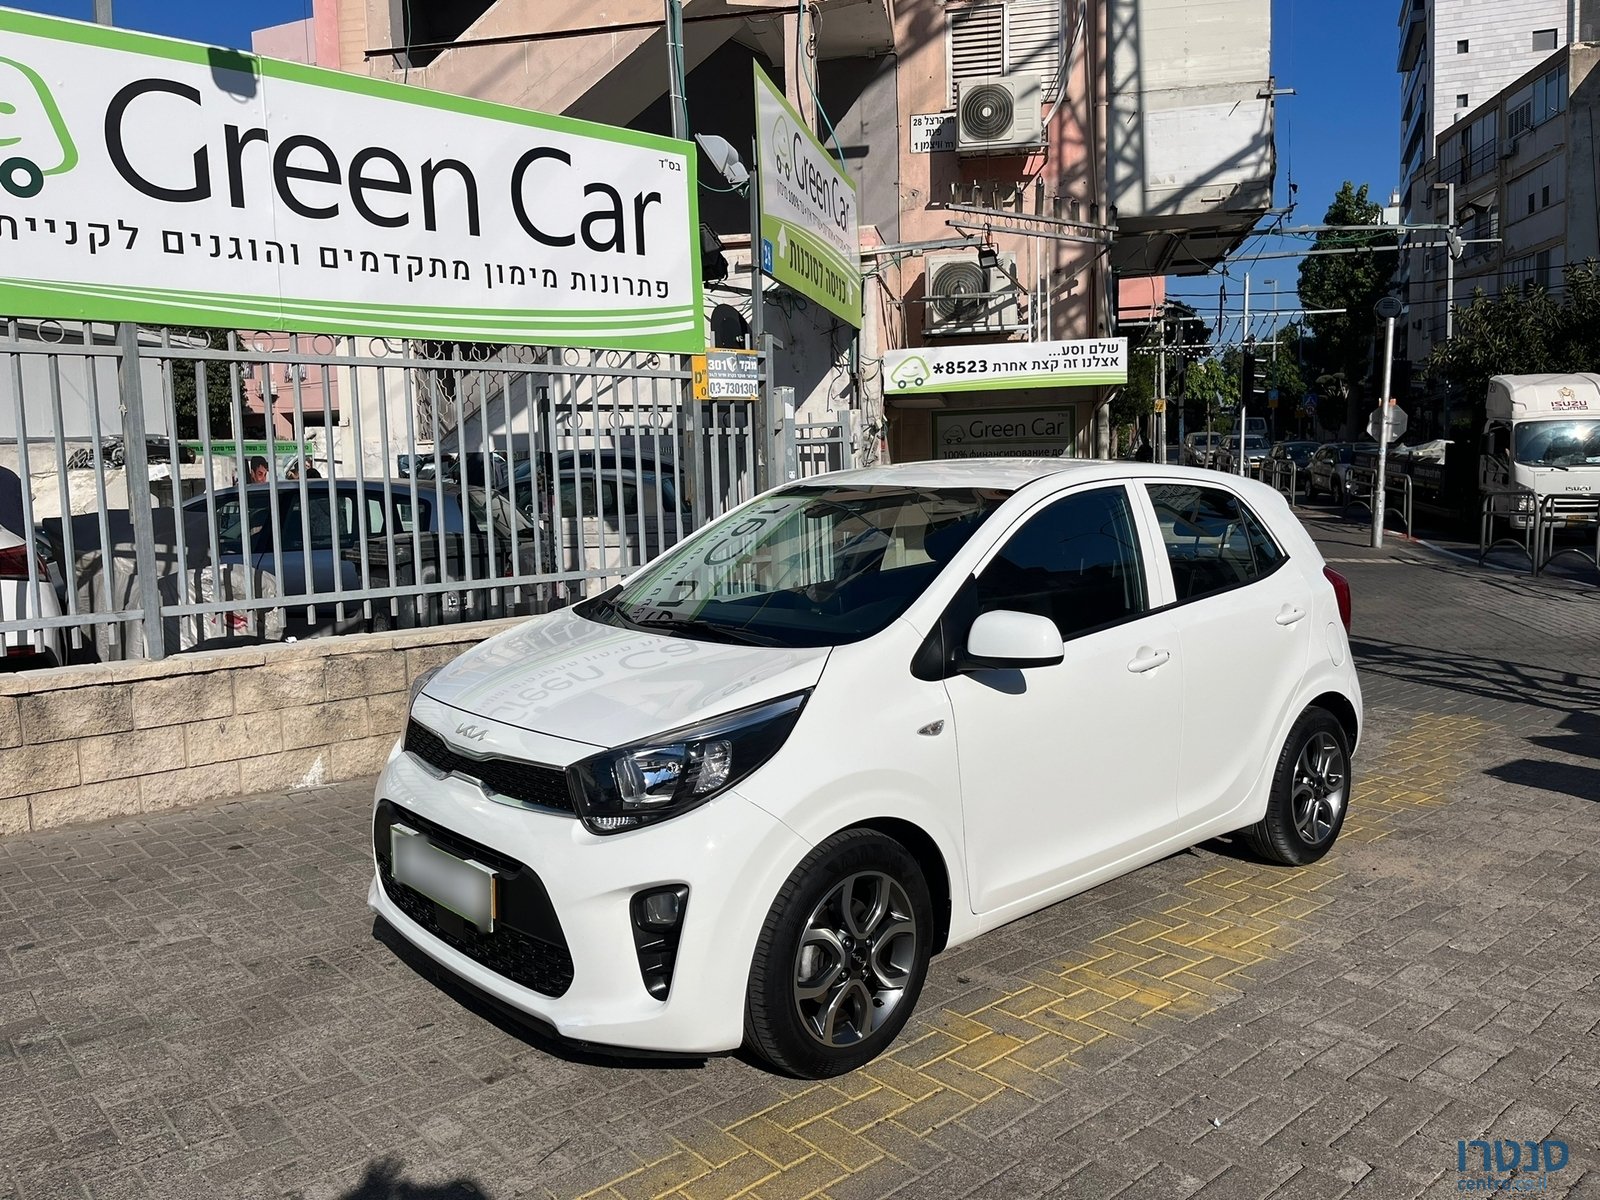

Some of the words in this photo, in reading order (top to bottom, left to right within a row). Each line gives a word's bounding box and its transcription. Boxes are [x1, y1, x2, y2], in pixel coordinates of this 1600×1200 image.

[913, 118, 922, 126] 28
[924, 116, 945, 125] הרצל
[914, 142, 918, 150] 1
[104, 78, 481, 236] Green
[510, 147, 662, 256] Car
[793, 131, 831, 218] Green
[832, 177, 850, 233] Car
[0, 214, 138, 254] לקניית
[162, 230, 299, 265] והוגנים
[319, 246, 470, 282] מתקדמים
[789, 239, 824, 288] לסוכנות
[485, 263, 557, 288] מימון
[571, 271, 669, 298] פתרונות
[826, 267, 846, 304] כניסה
[1048, 345, 1084, 357] וסע...
[1089, 342, 1118, 354] שלם
[708, 360, 726, 371] 301
[992, 361, 1027, 372] אחרת
[1031, 360, 1059, 372] קצת
[1063, 359, 1078, 368] זה
[1082, 356, 1119, 368] אצלנו
[710, 382, 757, 395] 03-7301301
[969, 420, 1026, 438] Green
[1031, 418, 1064, 436] Car
[943, 449, 968, 459] 100%
